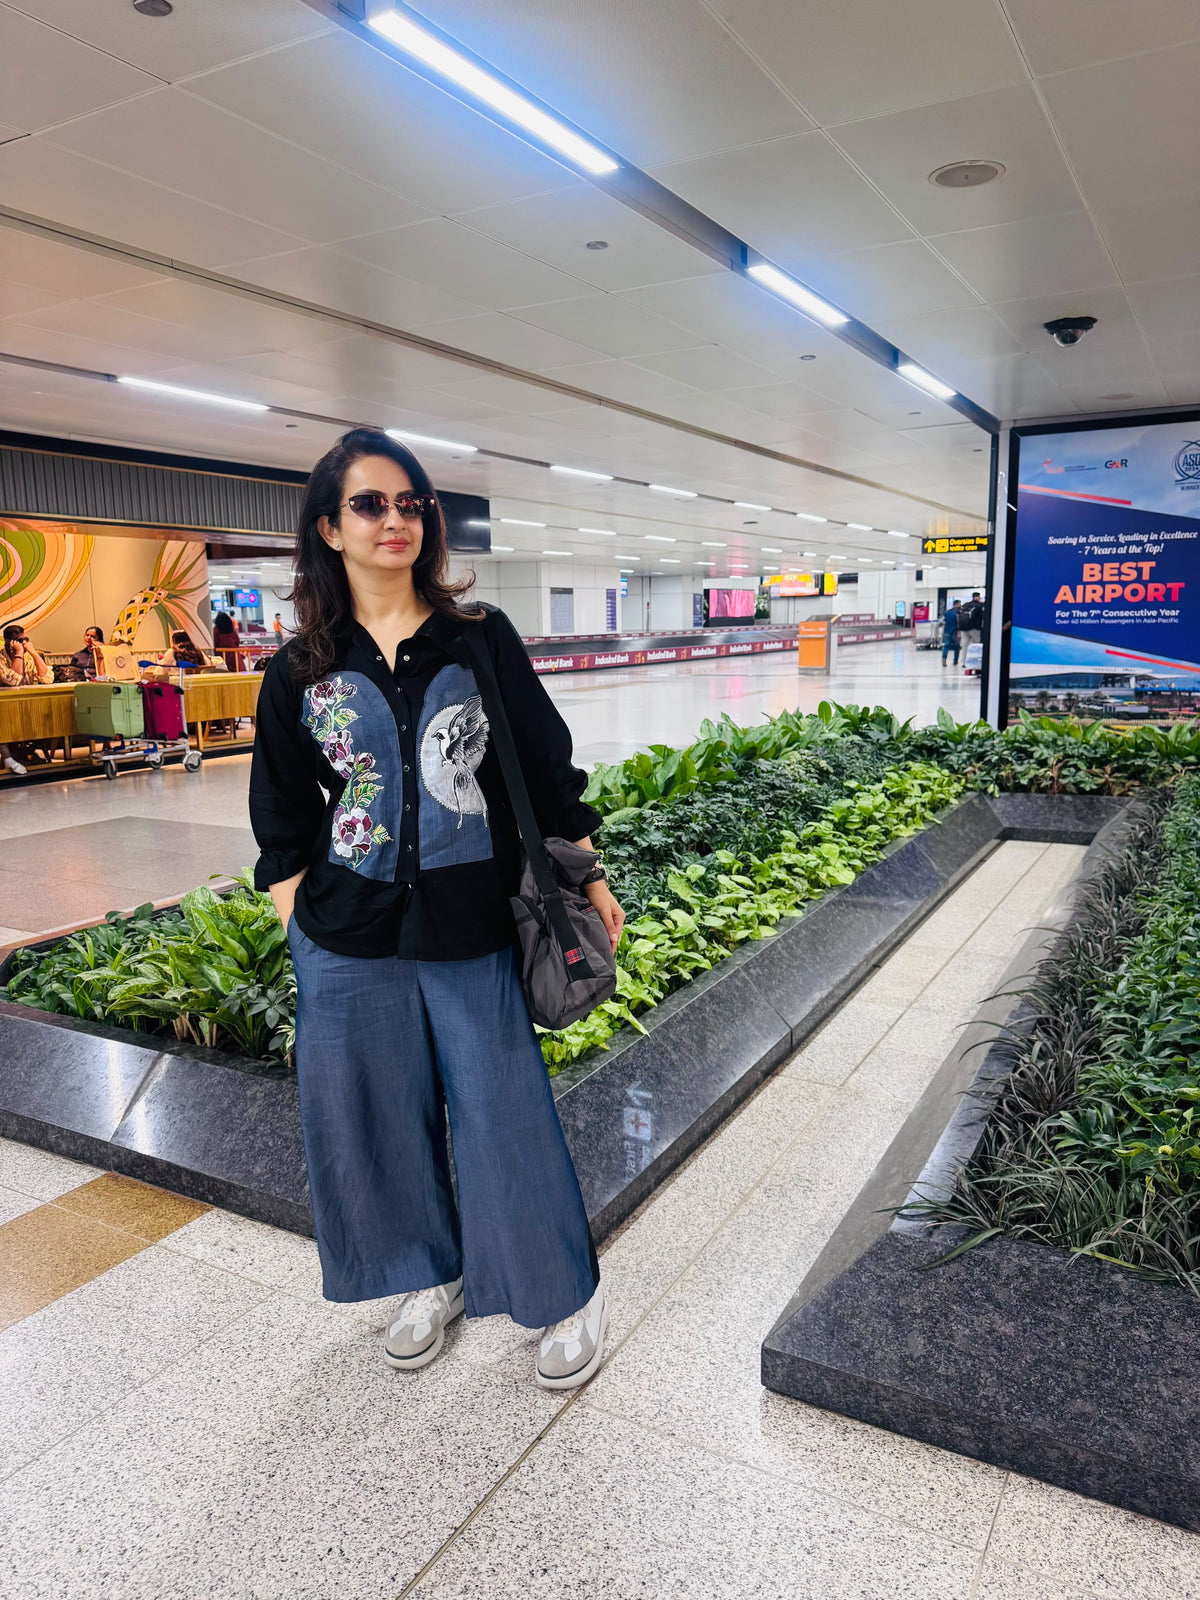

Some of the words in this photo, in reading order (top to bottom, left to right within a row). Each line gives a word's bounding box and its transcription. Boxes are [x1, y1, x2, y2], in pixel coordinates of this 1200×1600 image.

[1048, 535, 1078, 546] Soaring
[1078, 535, 1087, 543] in
[1118, 532, 1149, 543] Leading
[1149, 532, 1158, 540] in
[1159, 531, 1198, 540] Excellence
[1084, 545, 1091, 555] 7
[1091, 545, 1116, 555] Years
[1117, 545, 1127, 554] at
[1128, 544, 1142, 554] the
[1143, 542, 1164, 555] Top!
[1082, 561, 1156, 582] BEST
[1053, 582, 1185, 604] AIRPORT
[1055, 610, 1070, 618] For
[1071, 609, 1088, 618] The
[1102, 608, 1157, 617] Consecutive
[1159, 608, 1180, 617] Year
[559, 657, 573, 667] Bank
[616, 653, 629, 663] Bank
